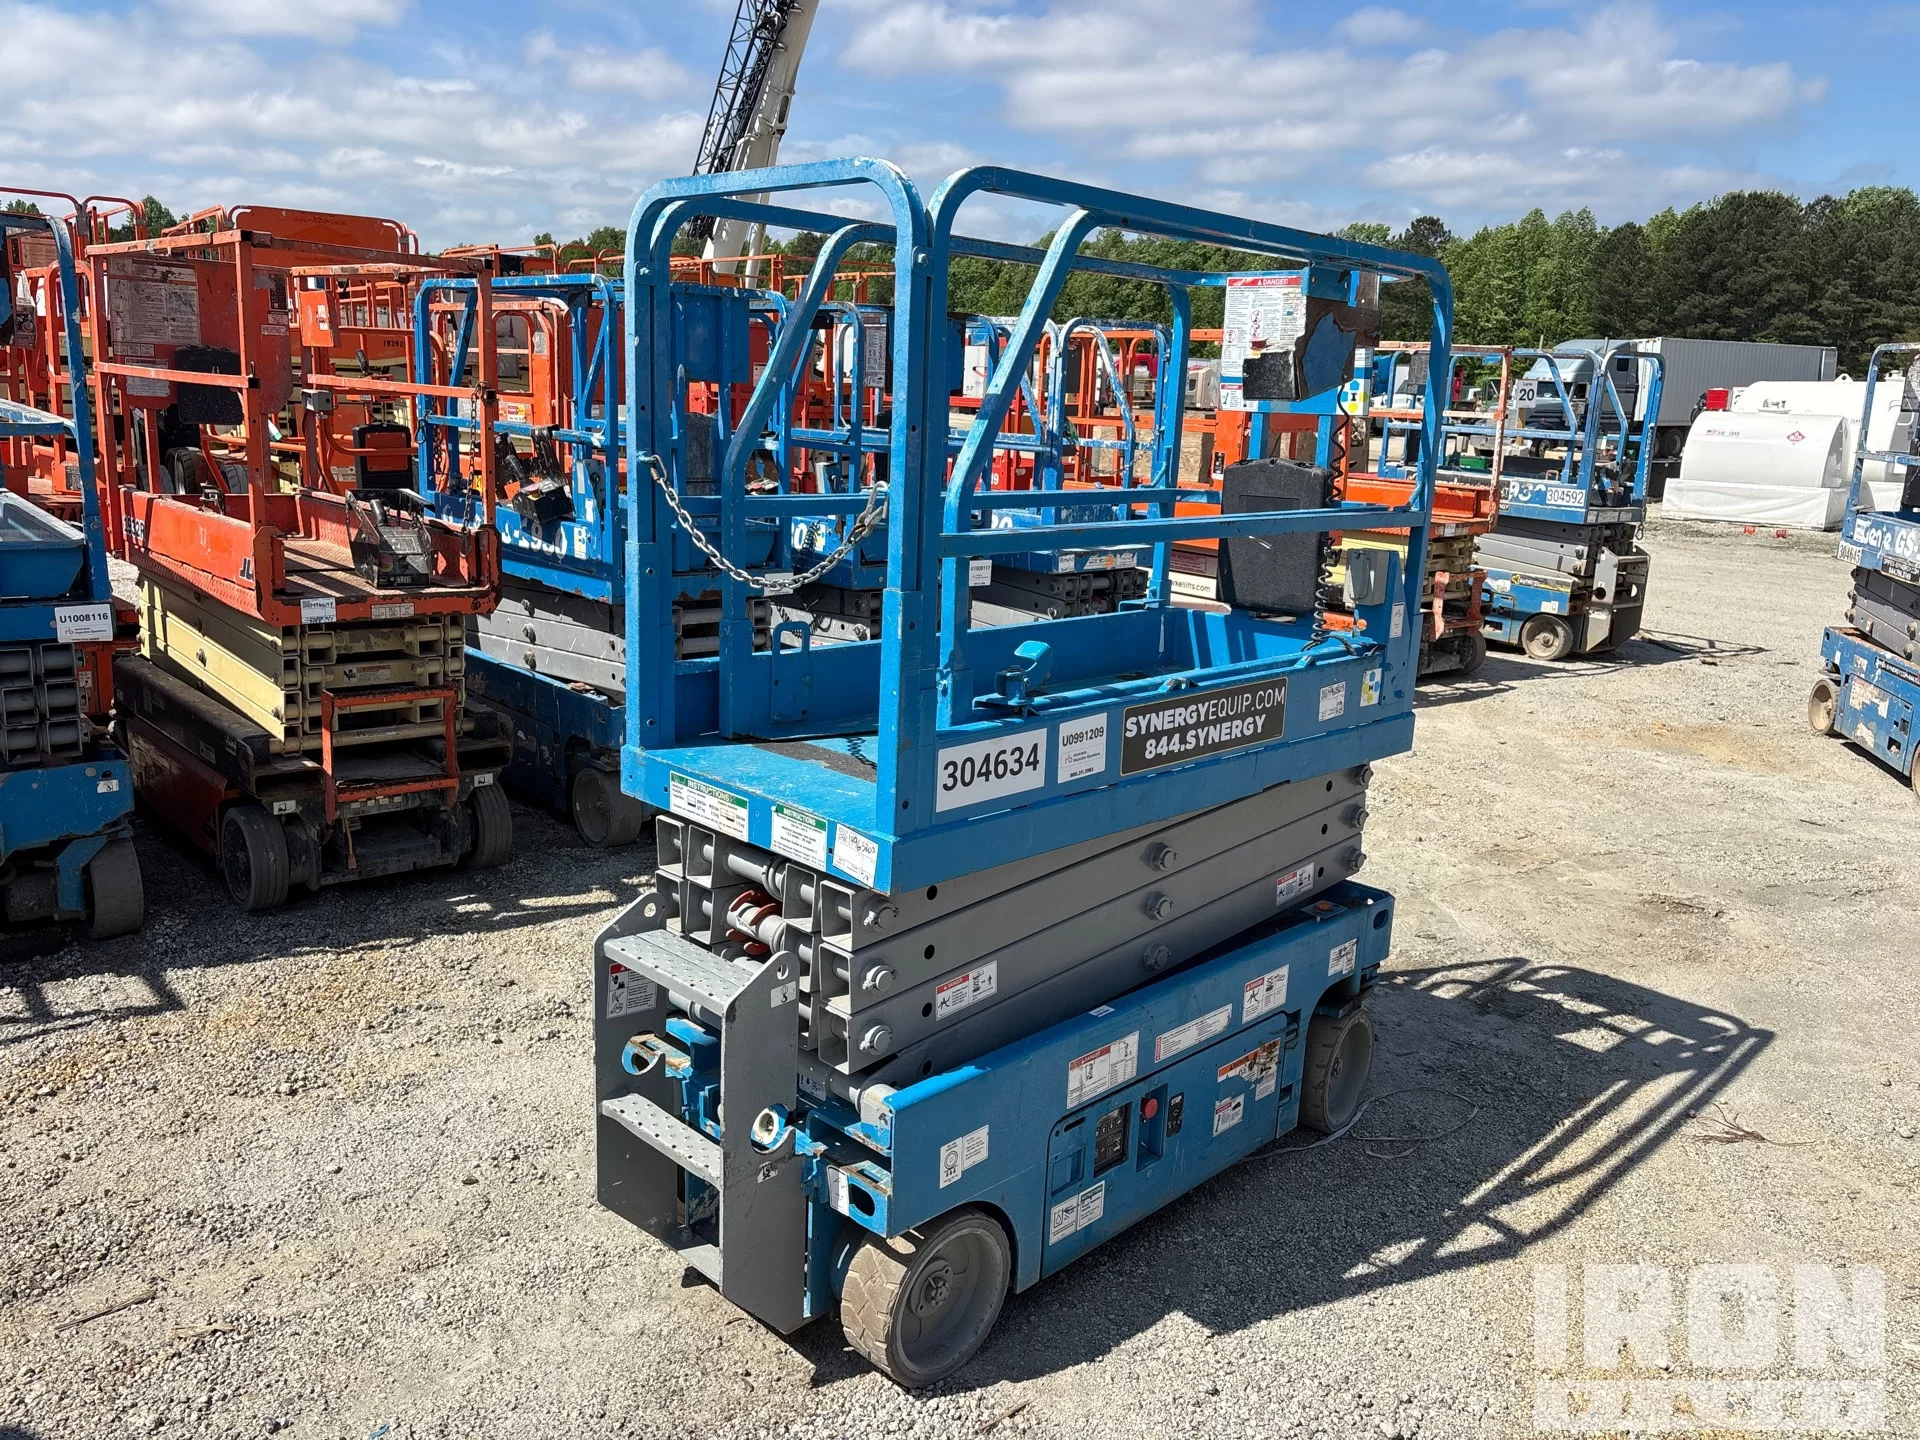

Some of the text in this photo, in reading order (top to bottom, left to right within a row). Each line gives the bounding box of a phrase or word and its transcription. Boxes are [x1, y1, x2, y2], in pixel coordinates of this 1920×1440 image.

[1518, 388, 1535, 401] 20
[1547, 488, 1584, 504] 304592
[1838, 543, 1861, 563] 304645
[239, 557, 254, 582] JL
[59, 612, 109, 624] U1008116
[1125, 685, 1285, 738] SYNERGYEQUIP.COM
[1062, 726, 1104, 747] U0991209
[1144, 714, 1267, 760] 844.SYNERGY
[942, 742, 1040, 792] 304634
[687, 779, 730, 802] INSTRUCTIONS
